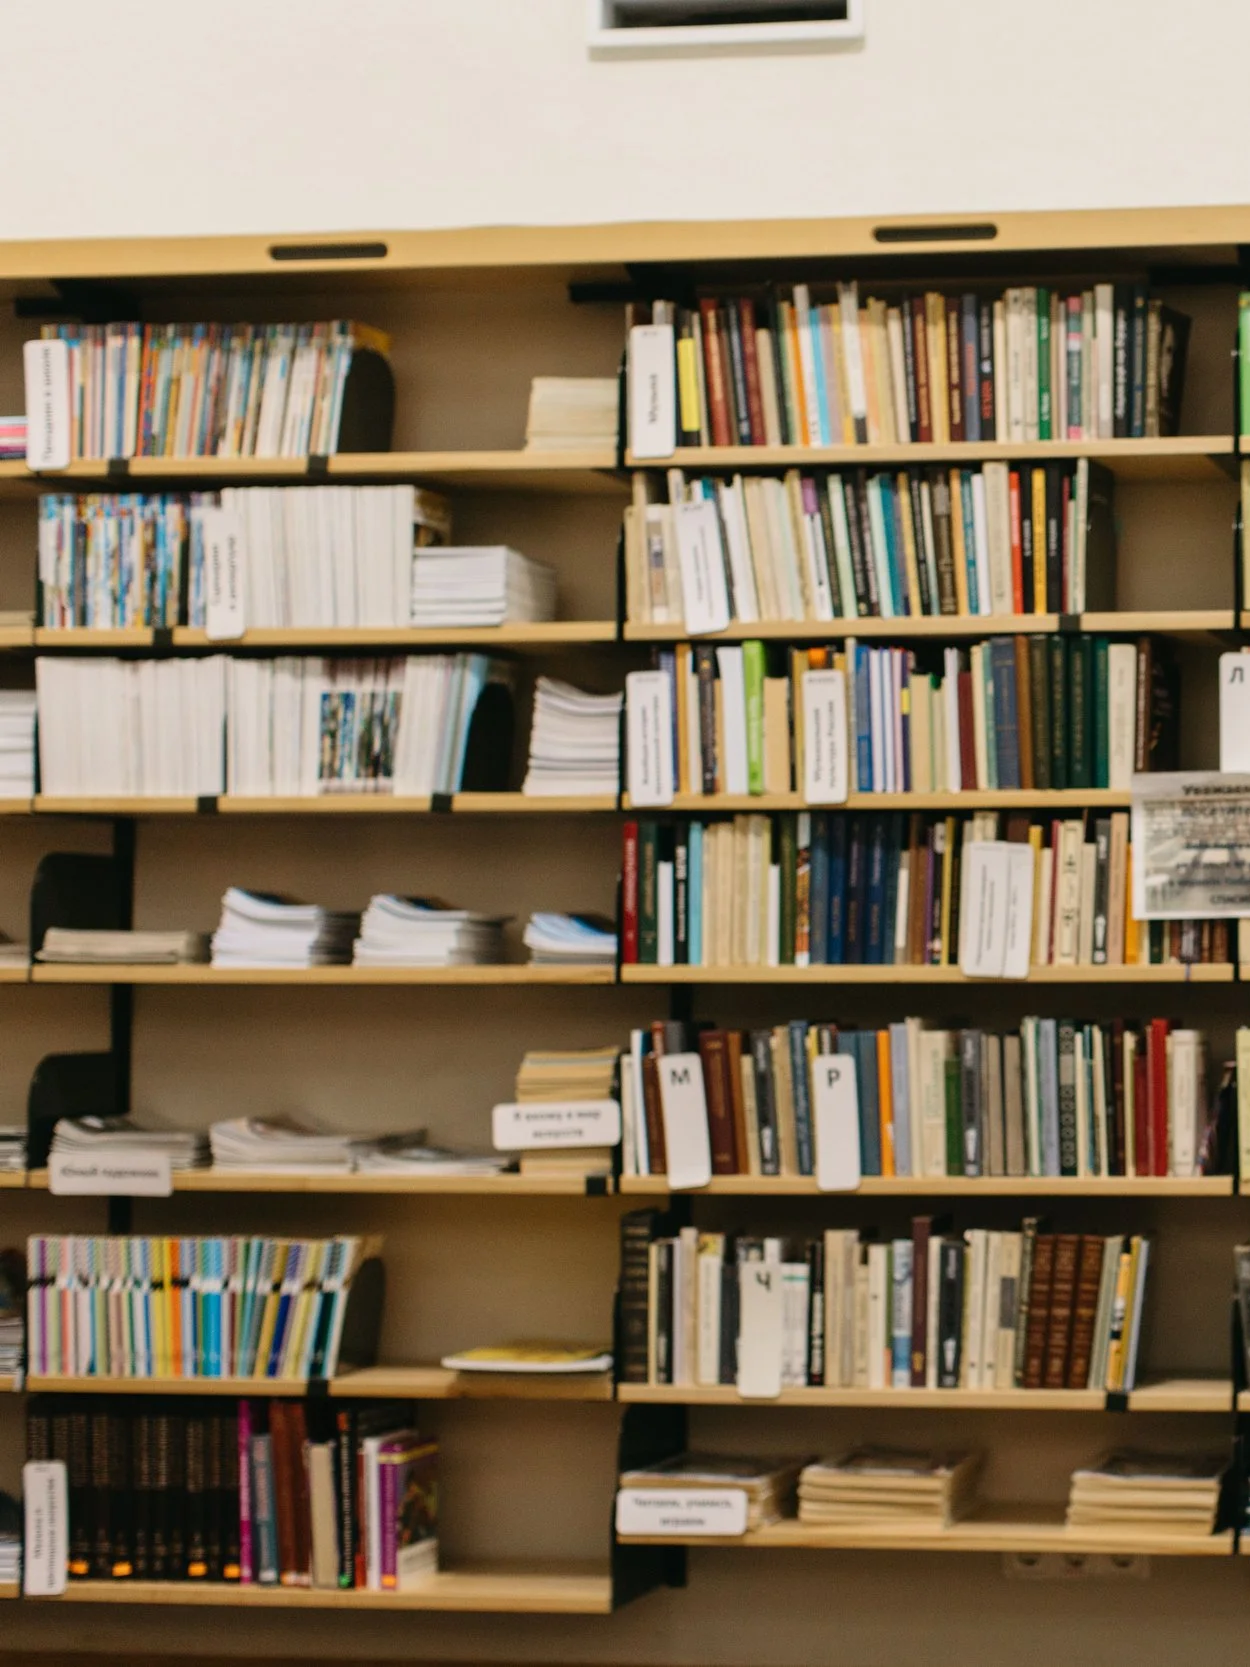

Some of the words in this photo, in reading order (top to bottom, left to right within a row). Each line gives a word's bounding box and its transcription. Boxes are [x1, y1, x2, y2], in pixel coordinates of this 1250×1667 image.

[1229, 666, 1245, 684] Л
[670, 1067, 690, 1086] М
[826, 1068, 841, 1088] Р
[756, 1272, 772, 1291] Ч
